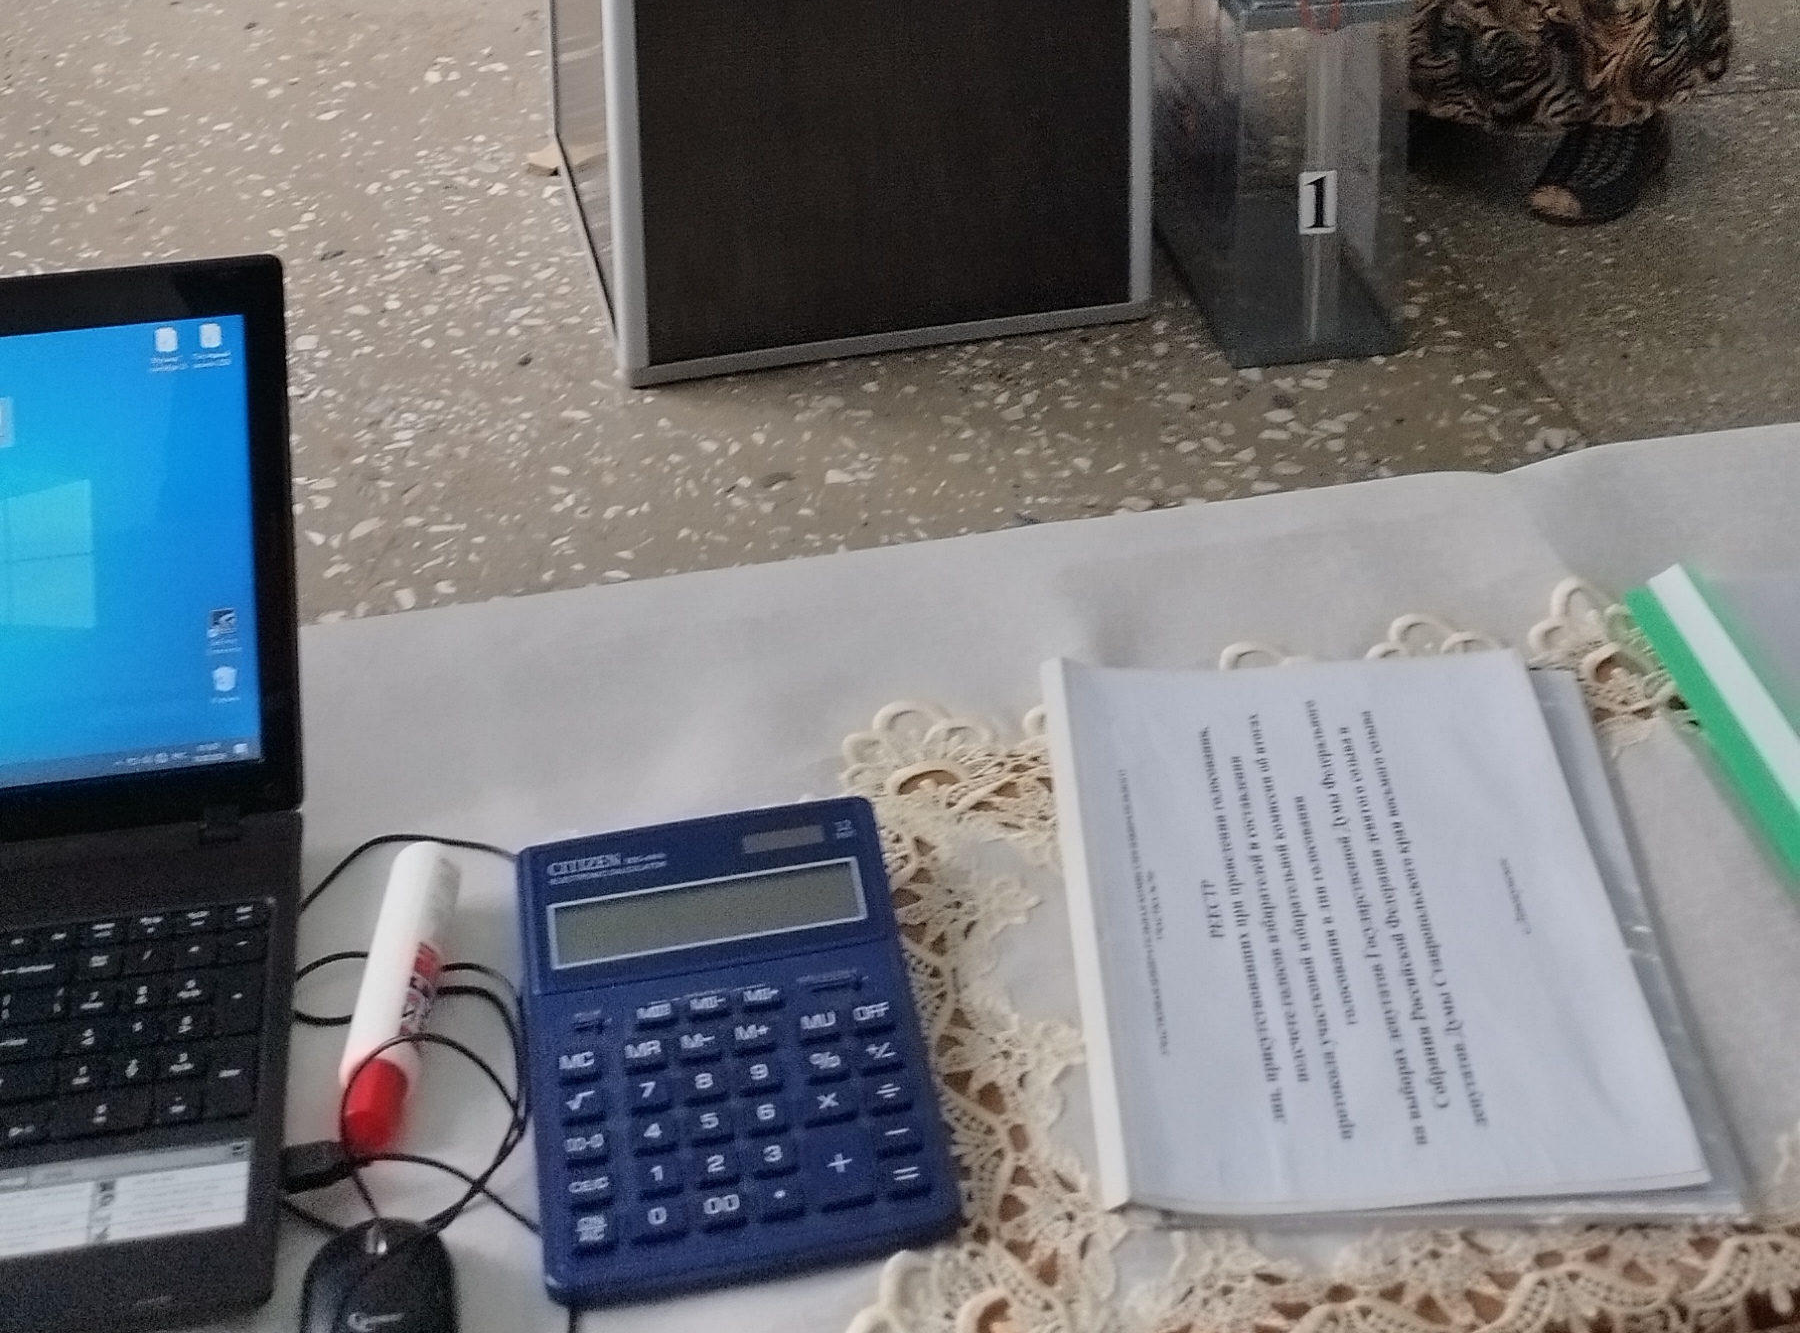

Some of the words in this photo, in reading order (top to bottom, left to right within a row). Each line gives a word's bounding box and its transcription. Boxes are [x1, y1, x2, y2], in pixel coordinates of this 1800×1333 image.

[1304, 175, 1330, 229] 1
[1390, 820, 1411, 854] края
[547, 853, 621, 876] CITIZEN
[1247, 853, 1279, 943] избирателей
[1199, 878, 1224, 939] РЕЕСТР
[1231, 899, 1251, 928] при
[1390, 932, 1426, 1021] Российской
[800, 1010, 836, 1030] MU
[852, 1002, 890, 1021] OFF
[625, 1039, 662, 1059] MR
[559, 1051, 595, 1070] MC
[1418, 1025, 1449, 1109] Собрания
[695, 1072, 714, 1089] 8
[750, 1063, 769, 1080] 9
[639, 1081, 656, 1098] 7
[1393, 1047, 1421, 1119] выборах
[700, 1112, 719, 1129] 5
[756, 1103, 776, 1120] 6
[643, 1122, 663, 1139] 4
[706, 1154, 725, 1173] 2
[762, 1144, 783, 1163] 3
[649, 1164, 664, 1182] 1
[703, 1194, 741, 1215] 00
[648, 1206, 667, 1226] 0
